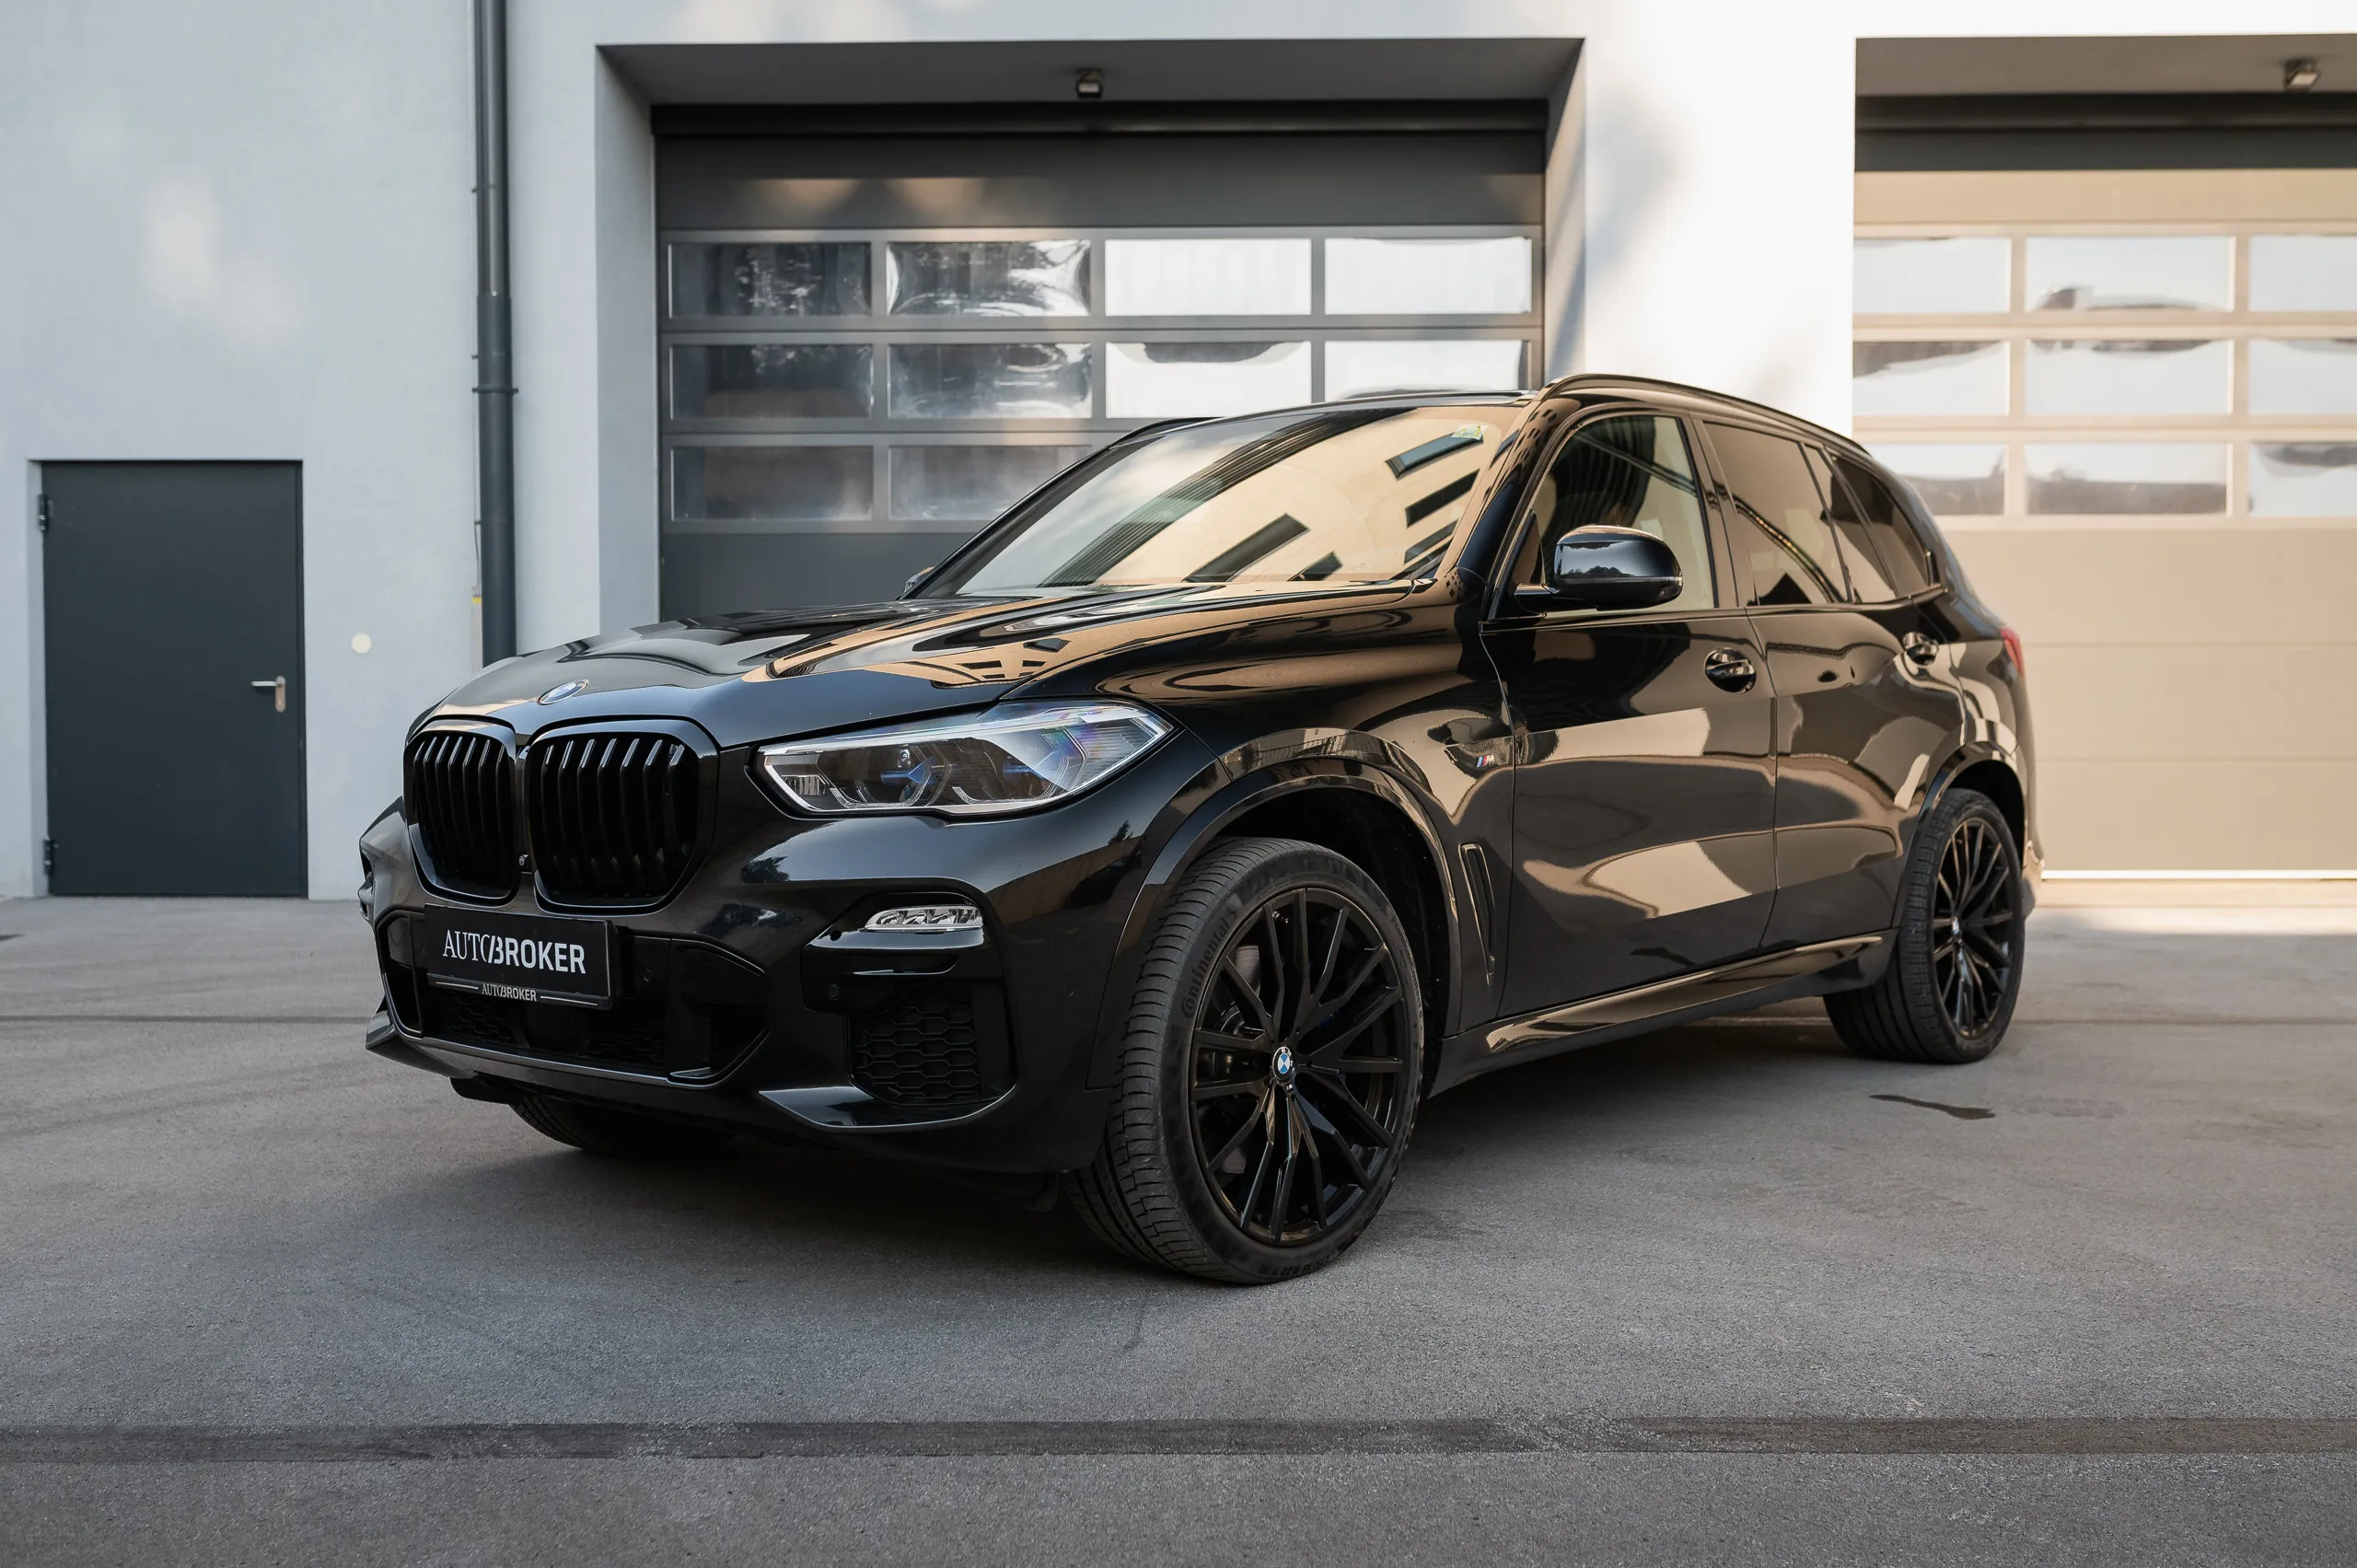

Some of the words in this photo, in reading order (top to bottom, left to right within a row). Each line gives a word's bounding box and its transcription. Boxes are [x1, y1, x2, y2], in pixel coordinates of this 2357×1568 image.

[442, 929, 586, 974] AUTOBROKER
[1180, 916, 1231, 1018] Continental
[482, 982, 538, 1002] AUTOBROKER
